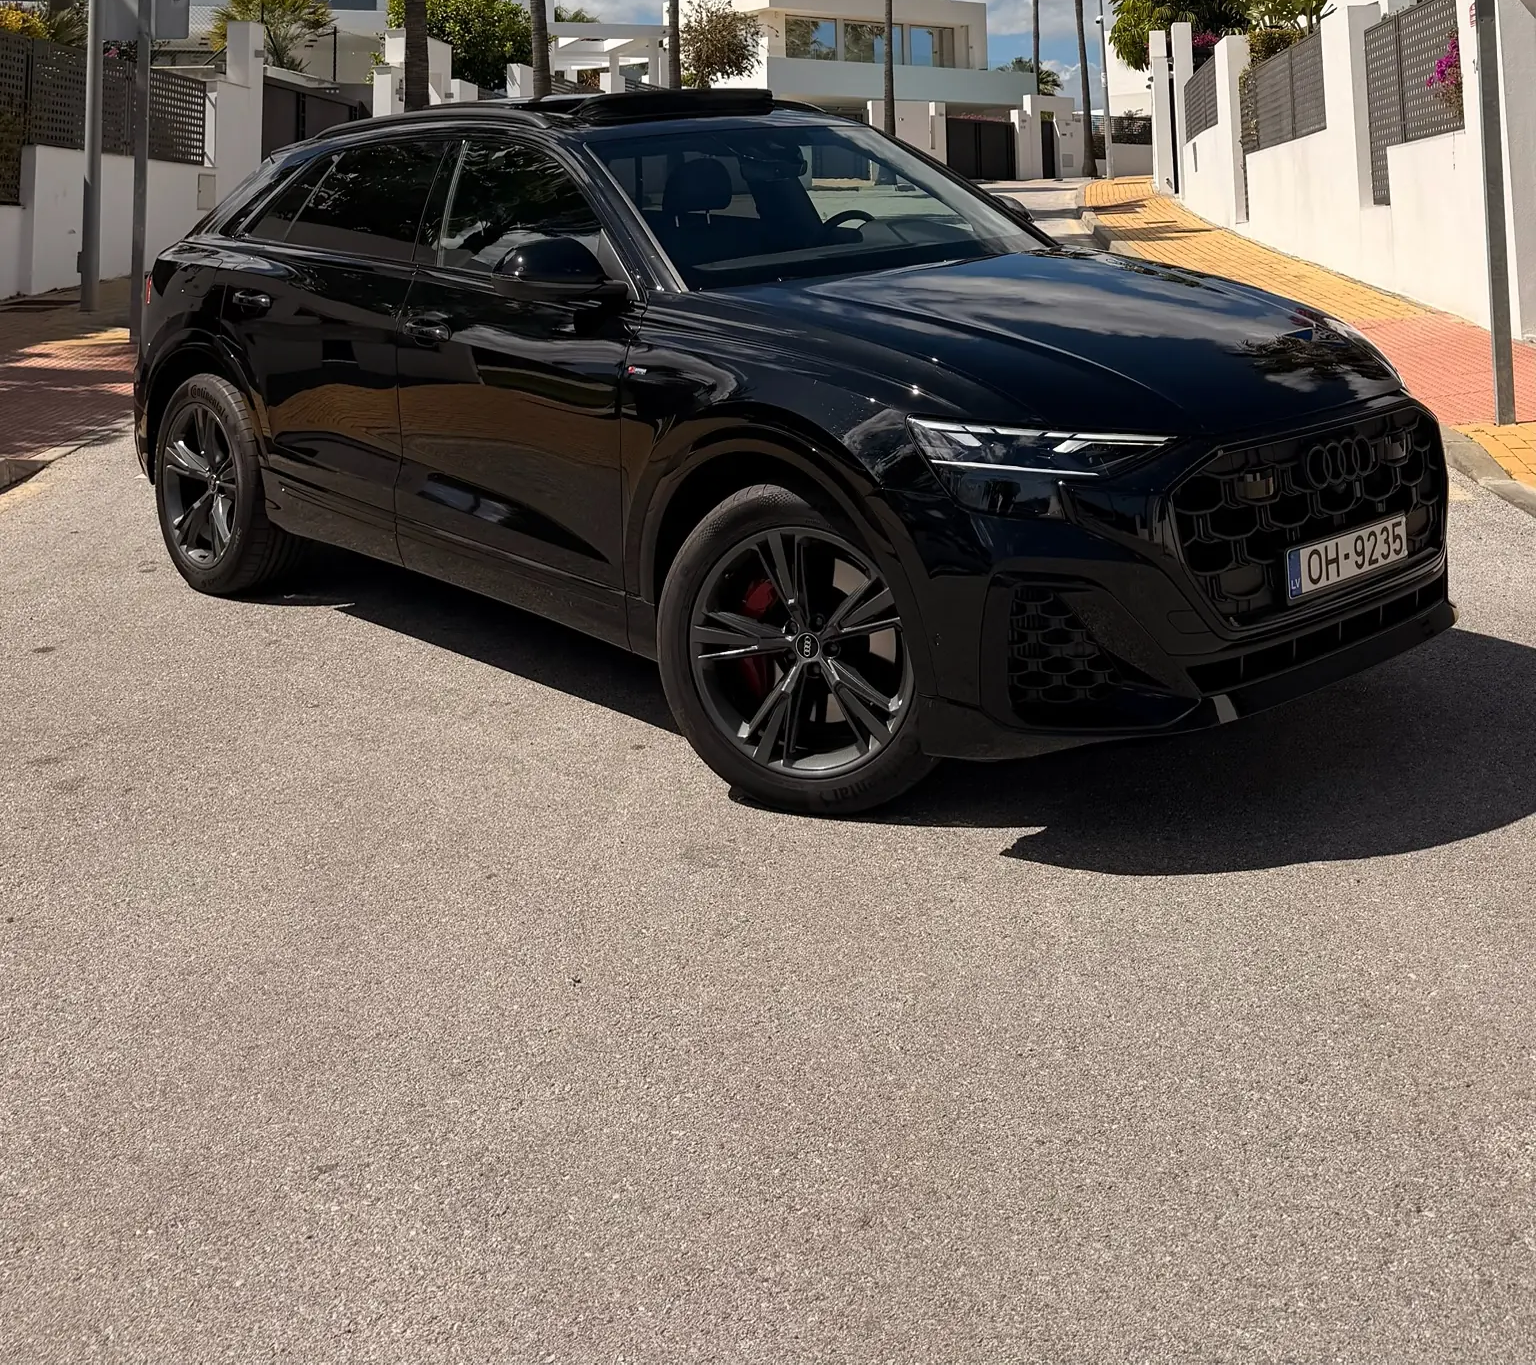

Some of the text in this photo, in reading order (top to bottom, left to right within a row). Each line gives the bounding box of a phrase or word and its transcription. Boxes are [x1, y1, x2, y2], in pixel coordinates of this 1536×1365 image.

[190, 384, 226, 417] Continental
[1307, 521, 1403, 585] OH-9235
[1290, 577, 1301, 590] LV
